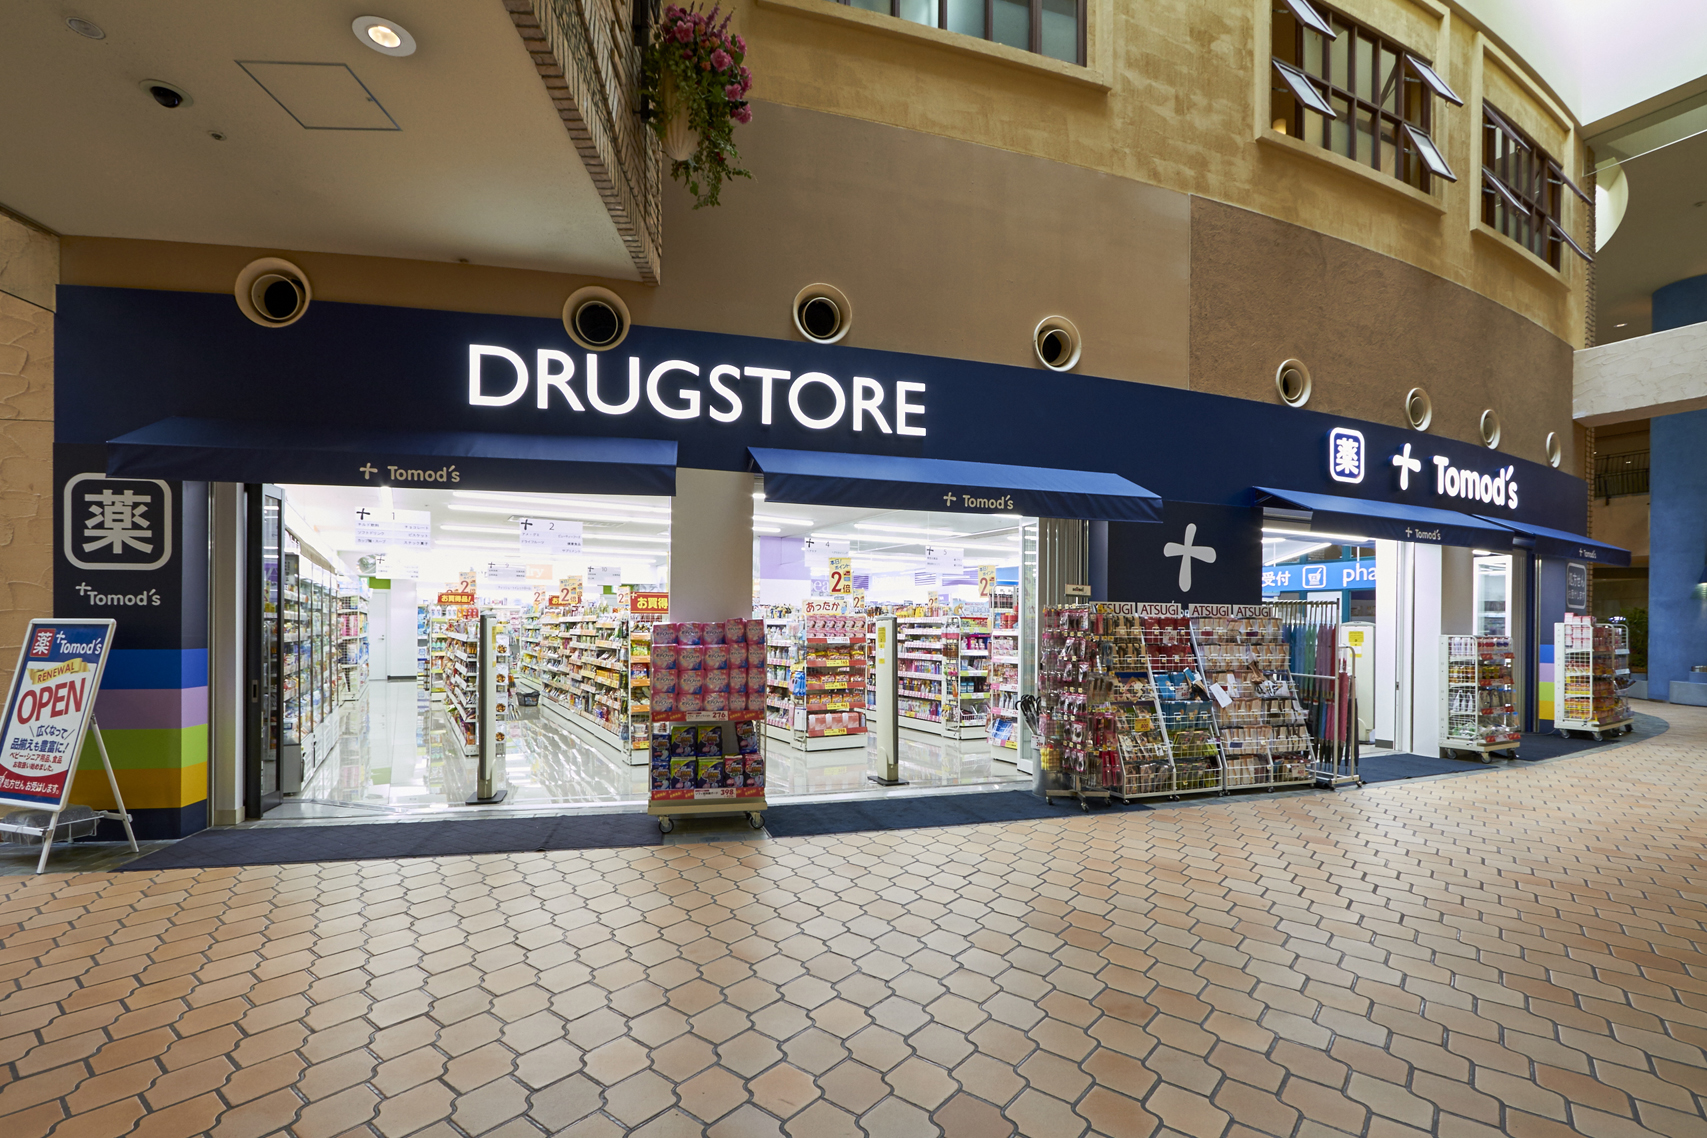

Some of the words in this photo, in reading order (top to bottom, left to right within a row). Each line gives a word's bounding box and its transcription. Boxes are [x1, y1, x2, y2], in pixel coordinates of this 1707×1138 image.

[468, 343, 927, 437] DRUGSTORE
[1335, 437, 1360, 475] 薬
[387, 464, 461, 483] Tomod's
[1432, 454, 1519, 510] Tomod's
[962, 494, 1014, 511] Tomod's
[82, 489, 154, 554] 薬
[549, 522, 555, 531] 2
[1415, 528, 1442, 541] Tomod's
[831, 571, 843, 593] 2
[87, 588, 161, 606] Tomod's
[805, 601, 840, 613] あったか
[1140, 603, 1179, 616] ATSUGI
[1192, 605, 1230, 617] ATSUGI
[1235, 606, 1272, 618] ATSUGI
[32, 631, 53, 655] 薬
[59, 638, 102, 655] Tomod's
[37, 661, 75, 684] RENEWAL
[17, 677, 86, 725] OPEN
[712, 711, 726, 719] 276
[35, 724, 69, 740] 広くなって
[720, 788, 734, 796] 398
